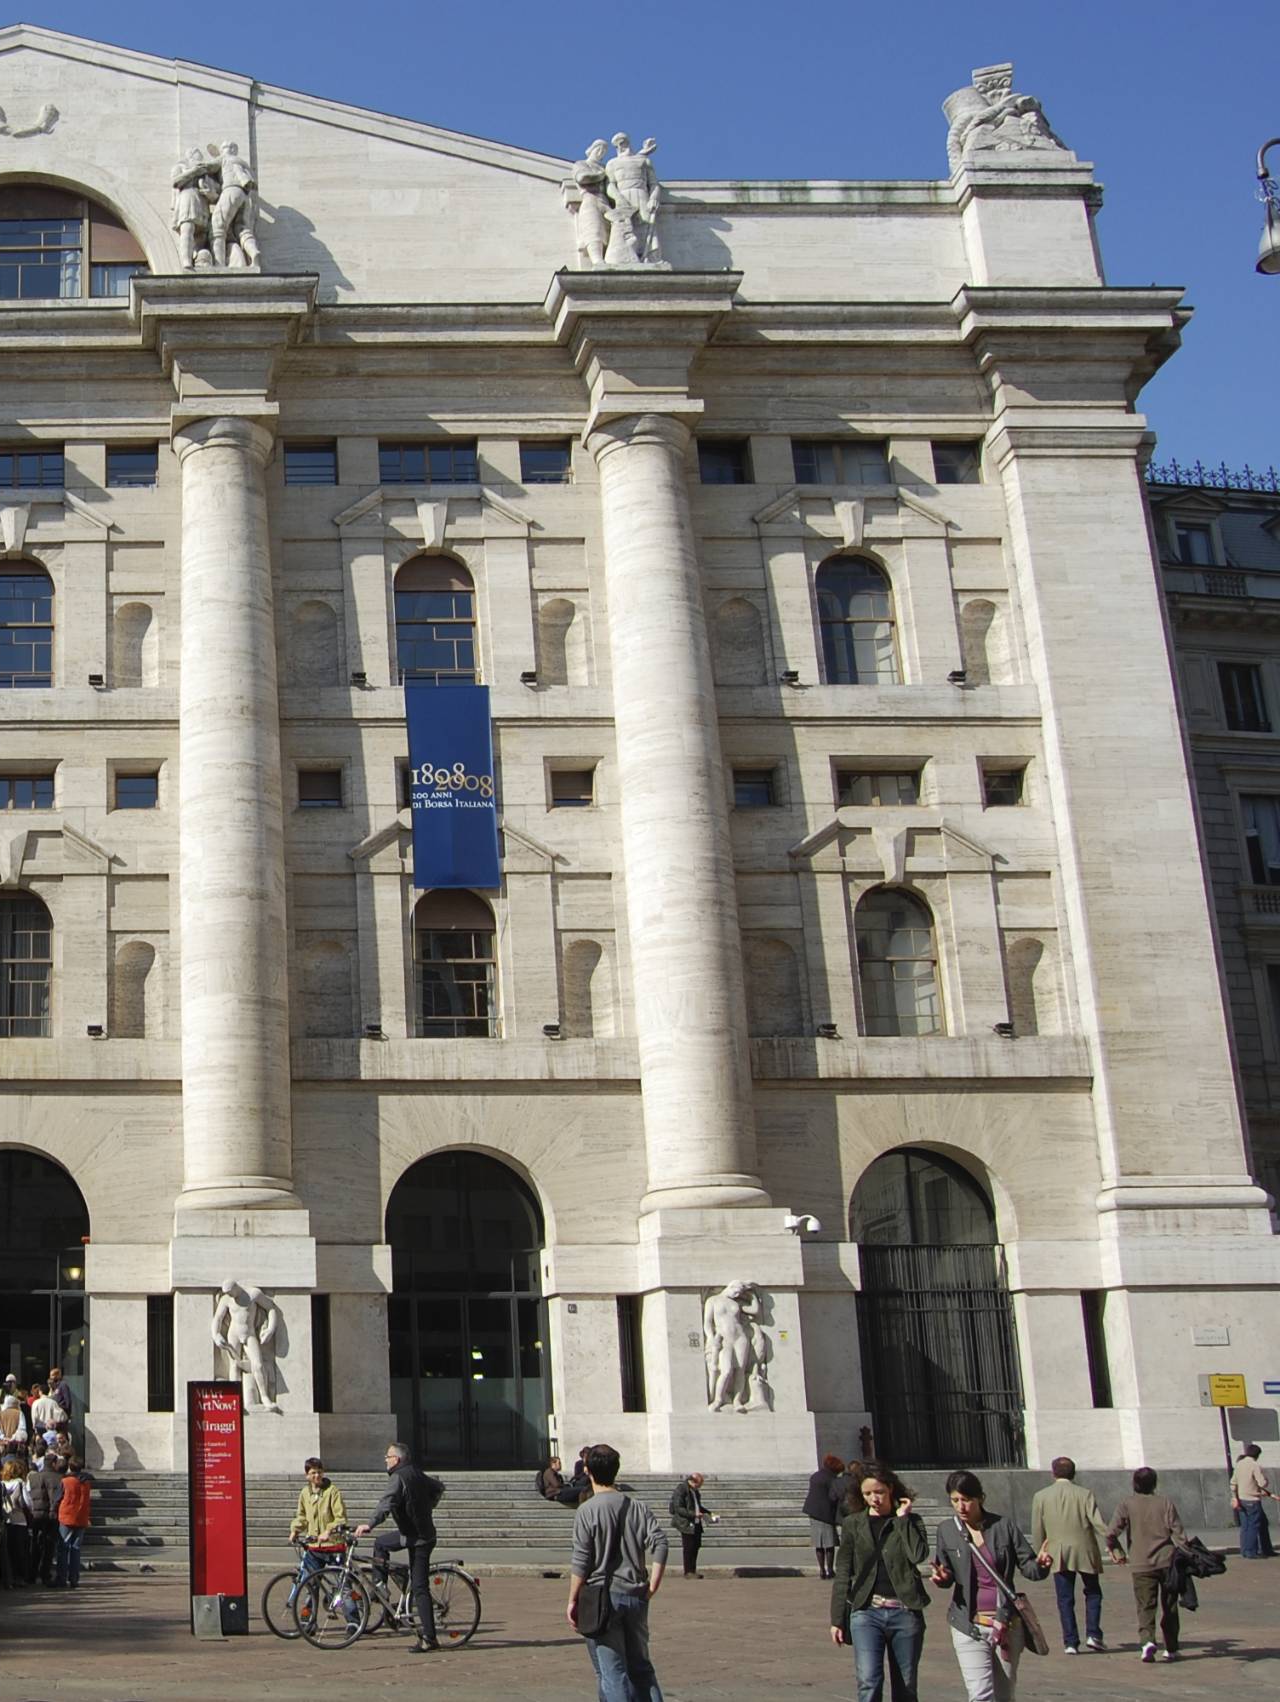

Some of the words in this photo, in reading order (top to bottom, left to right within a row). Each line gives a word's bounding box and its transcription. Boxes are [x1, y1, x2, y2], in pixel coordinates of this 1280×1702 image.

[411, 762, 465, 785] 1808
[434, 775, 493, 798] 2008
[195, 1420, 236, 1434] Miraggi
